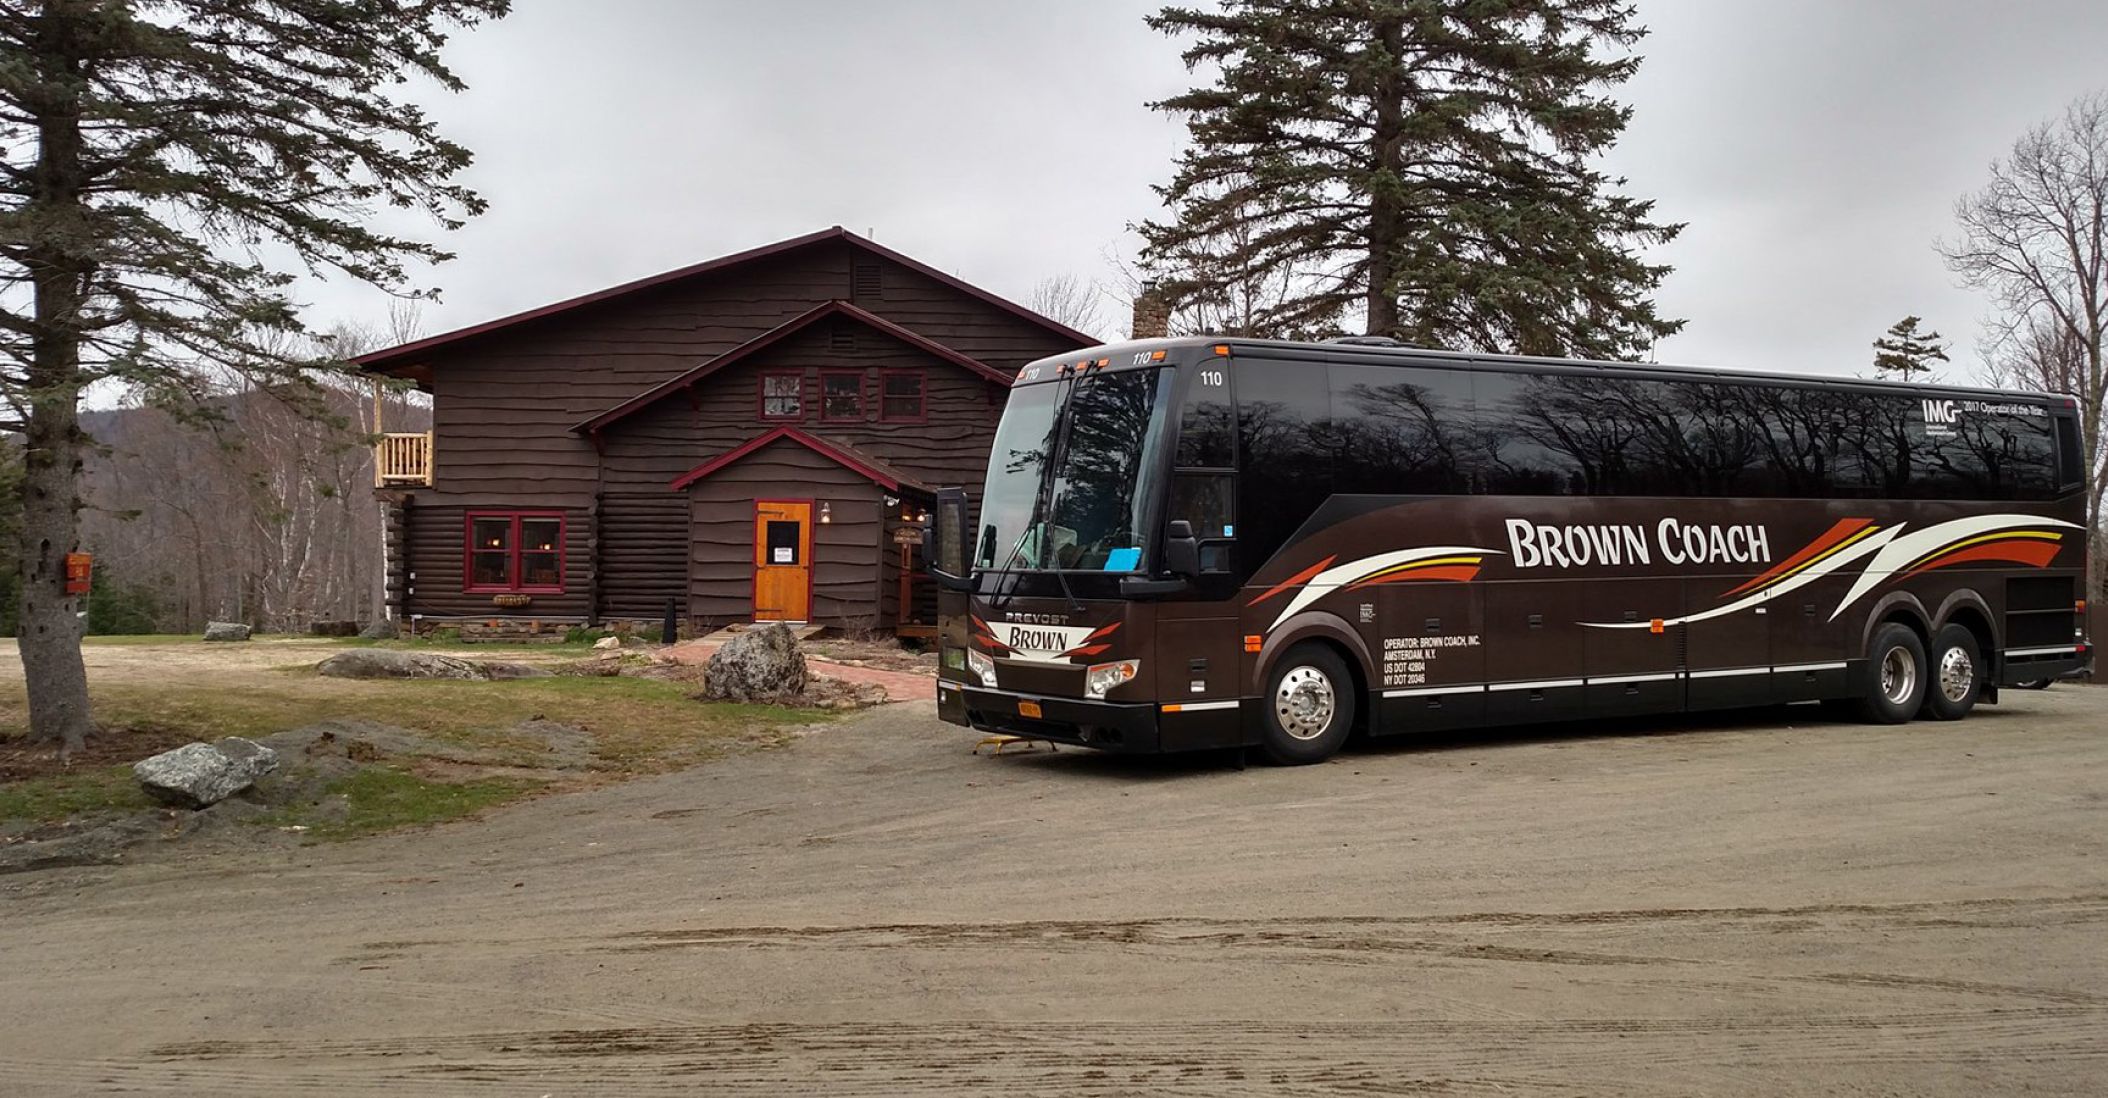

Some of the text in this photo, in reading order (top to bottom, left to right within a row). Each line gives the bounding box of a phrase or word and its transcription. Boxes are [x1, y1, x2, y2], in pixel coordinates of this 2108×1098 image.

[1133, 351, 1151, 365] 110
[1024, 368, 1040, 380] 110
[1201, 371, 1222, 386] 110
[1922, 399, 1962, 422] IMG
[1963, 400, 1979, 412] 2017
[1505, 517, 1771, 568] BROWN COACH
[1005, 612, 1069, 625] PREVOST
[1009, 626, 1068, 651] BROWN
[1420, 637, 1444, 648] BROWN
[1384, 663, 1393, 674] US
[1393, 662, 1407, 673] DOT
[1384, 675, 1393, 686] NY
[1393, 674, 1407, 686] DOT
